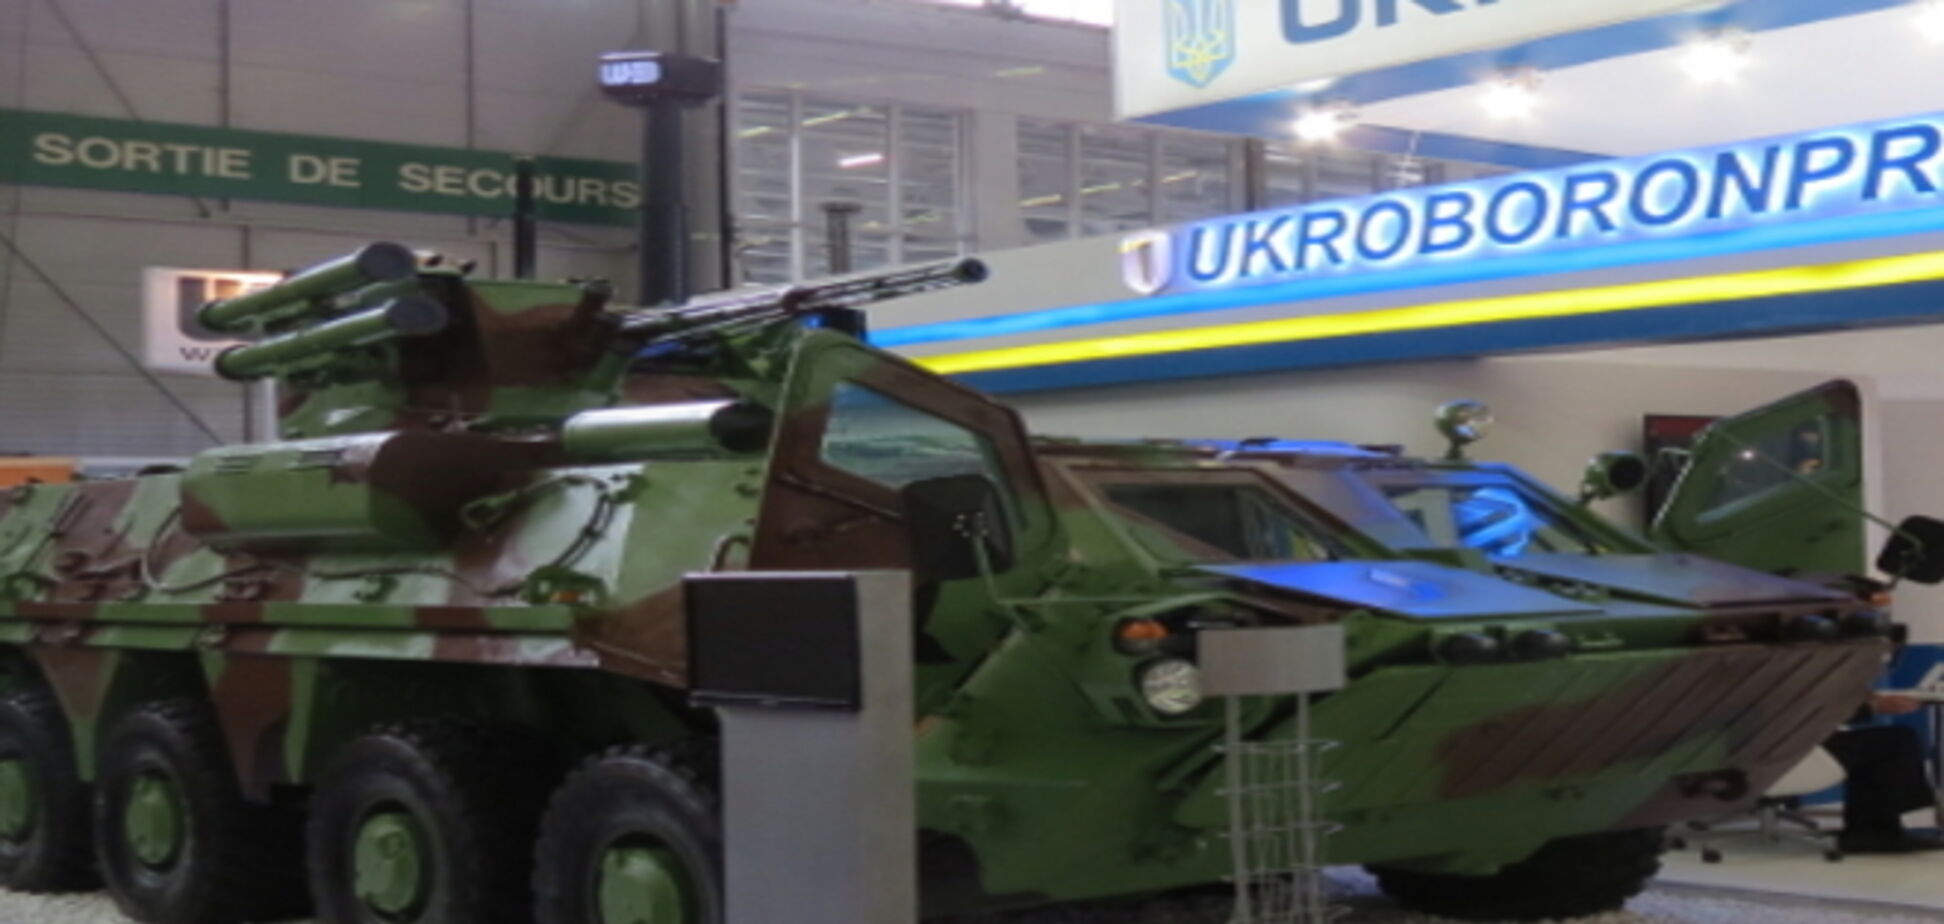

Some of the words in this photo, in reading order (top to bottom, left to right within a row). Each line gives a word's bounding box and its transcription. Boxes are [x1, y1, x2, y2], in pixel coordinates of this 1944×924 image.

[33, 132, 252, 179] SORTIE
[288, 154, 362, 188] DE
[1186, 123, 1942, 282] UKROBORONPR
